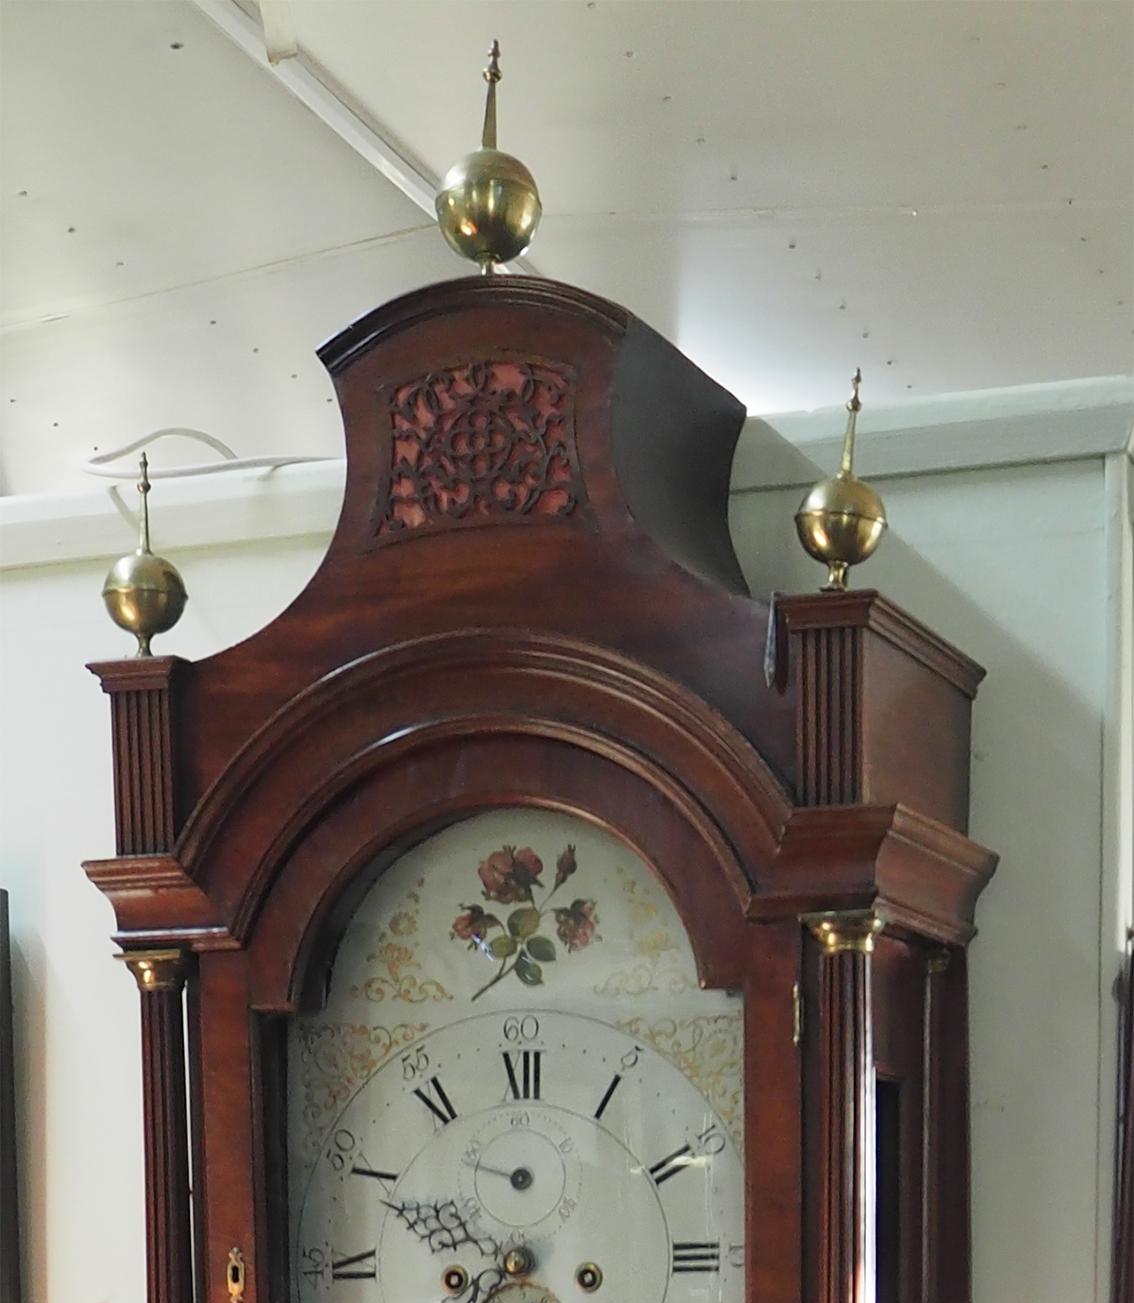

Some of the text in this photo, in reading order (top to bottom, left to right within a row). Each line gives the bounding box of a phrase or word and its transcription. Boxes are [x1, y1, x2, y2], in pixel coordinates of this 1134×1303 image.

[503, 1015, 540, 1041] 60
[401, 1045, 430, 1082] 55
[500, 1049, 547, 1101] XII
[620, 1045, 642, 1071] 5
[409, 1072, 461, 1136] XI
[595, 1071, 624, 1120] I
[510, 1111, 529, 1126] 60
[326, 1128, 356, 1172] 50
[697, 1123, 727, 1156] 10
[350, 1151, 399, 1198] X
[302, 1248, 325, 1291] 45
[331, 1248, 378, 1285] IX
[671, 1239, 720, 1275] III
